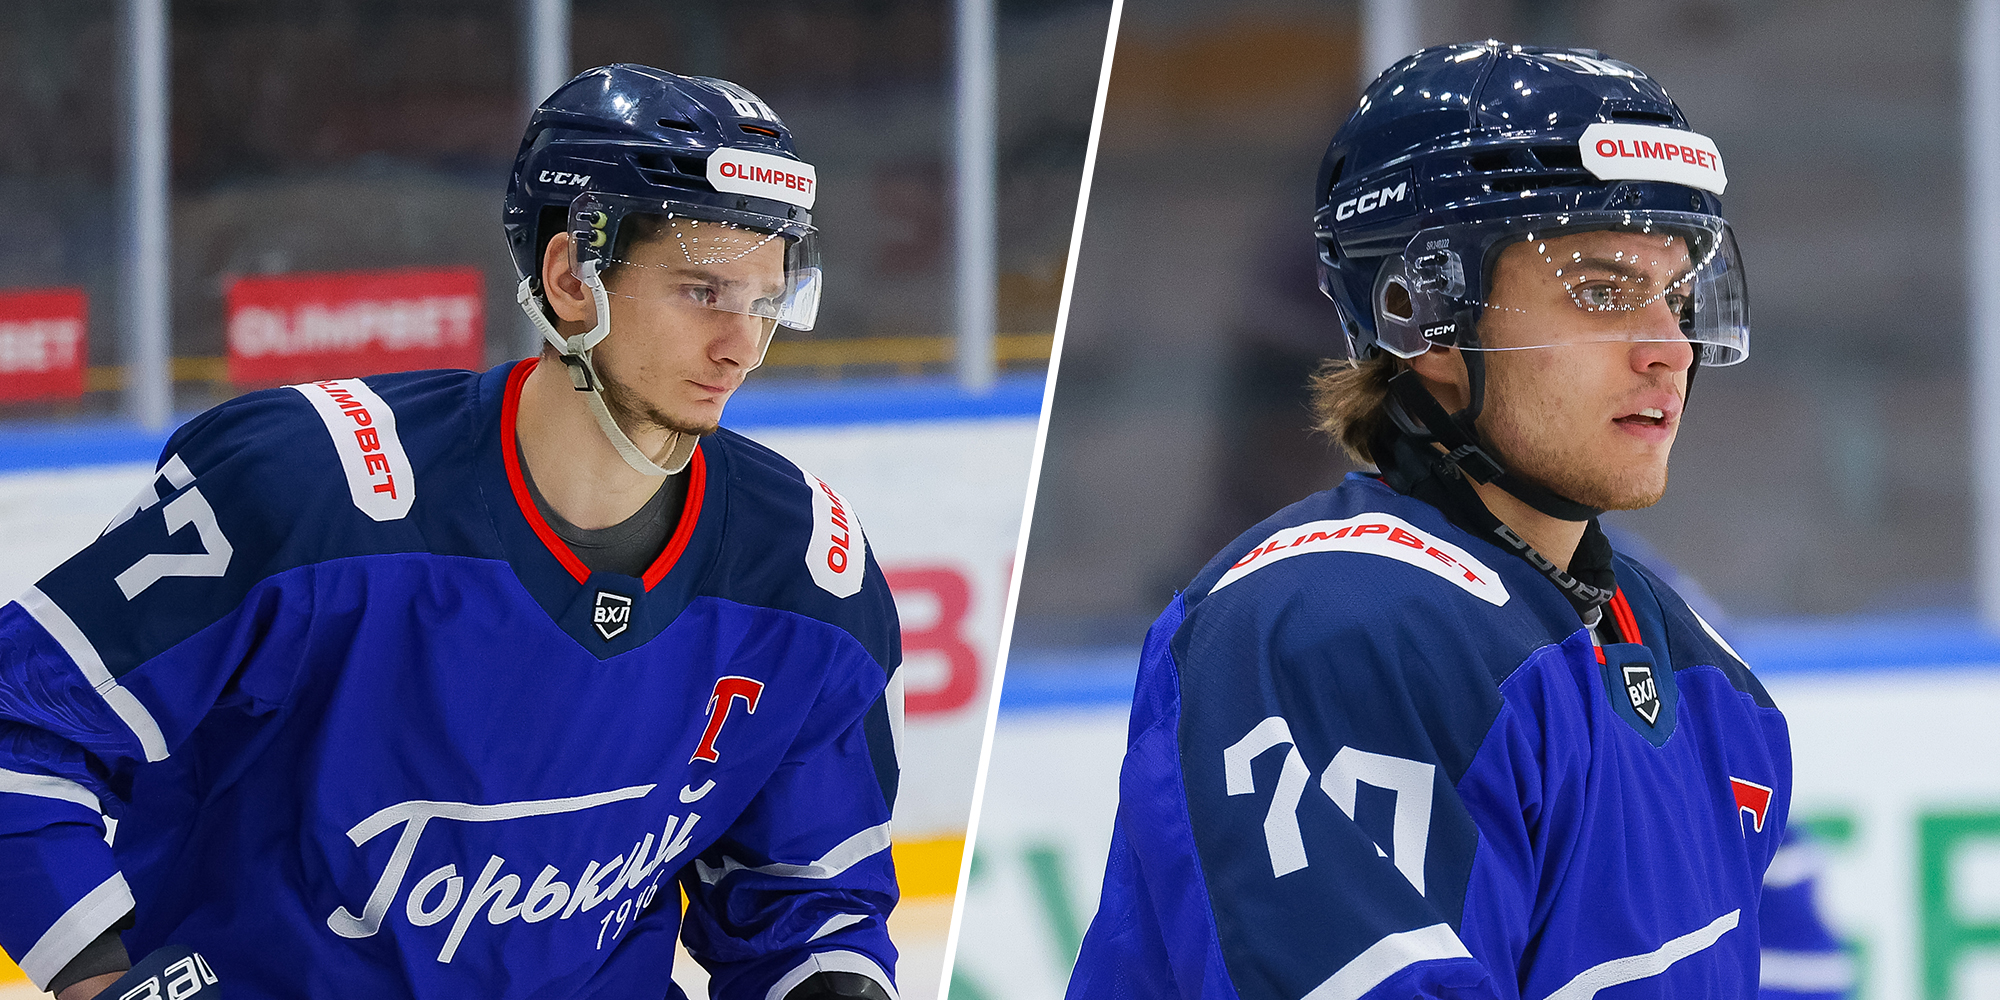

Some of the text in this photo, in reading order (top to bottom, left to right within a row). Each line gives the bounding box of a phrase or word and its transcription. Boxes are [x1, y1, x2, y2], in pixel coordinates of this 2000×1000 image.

[1595, 139, 1718, 172] OLIMPBET
[538, 169, 592, 188] CCM
[719, 161, 813, 194] OLIMPBET
[1335, 181, 1407, 222] CCM
[230, 298, 473, 356] OLIMPBET
[1424, 323, 1456, 338] CCM
[311, 379, 397, 500] LIMPBET
[814, 476, 849, 574] OLIMP
[1230, 523, 1487, 586] OLIMPBET
[594, 605, 631, 624] ВХЛ
[1628, 677, 1657, 707] ВХЛ
